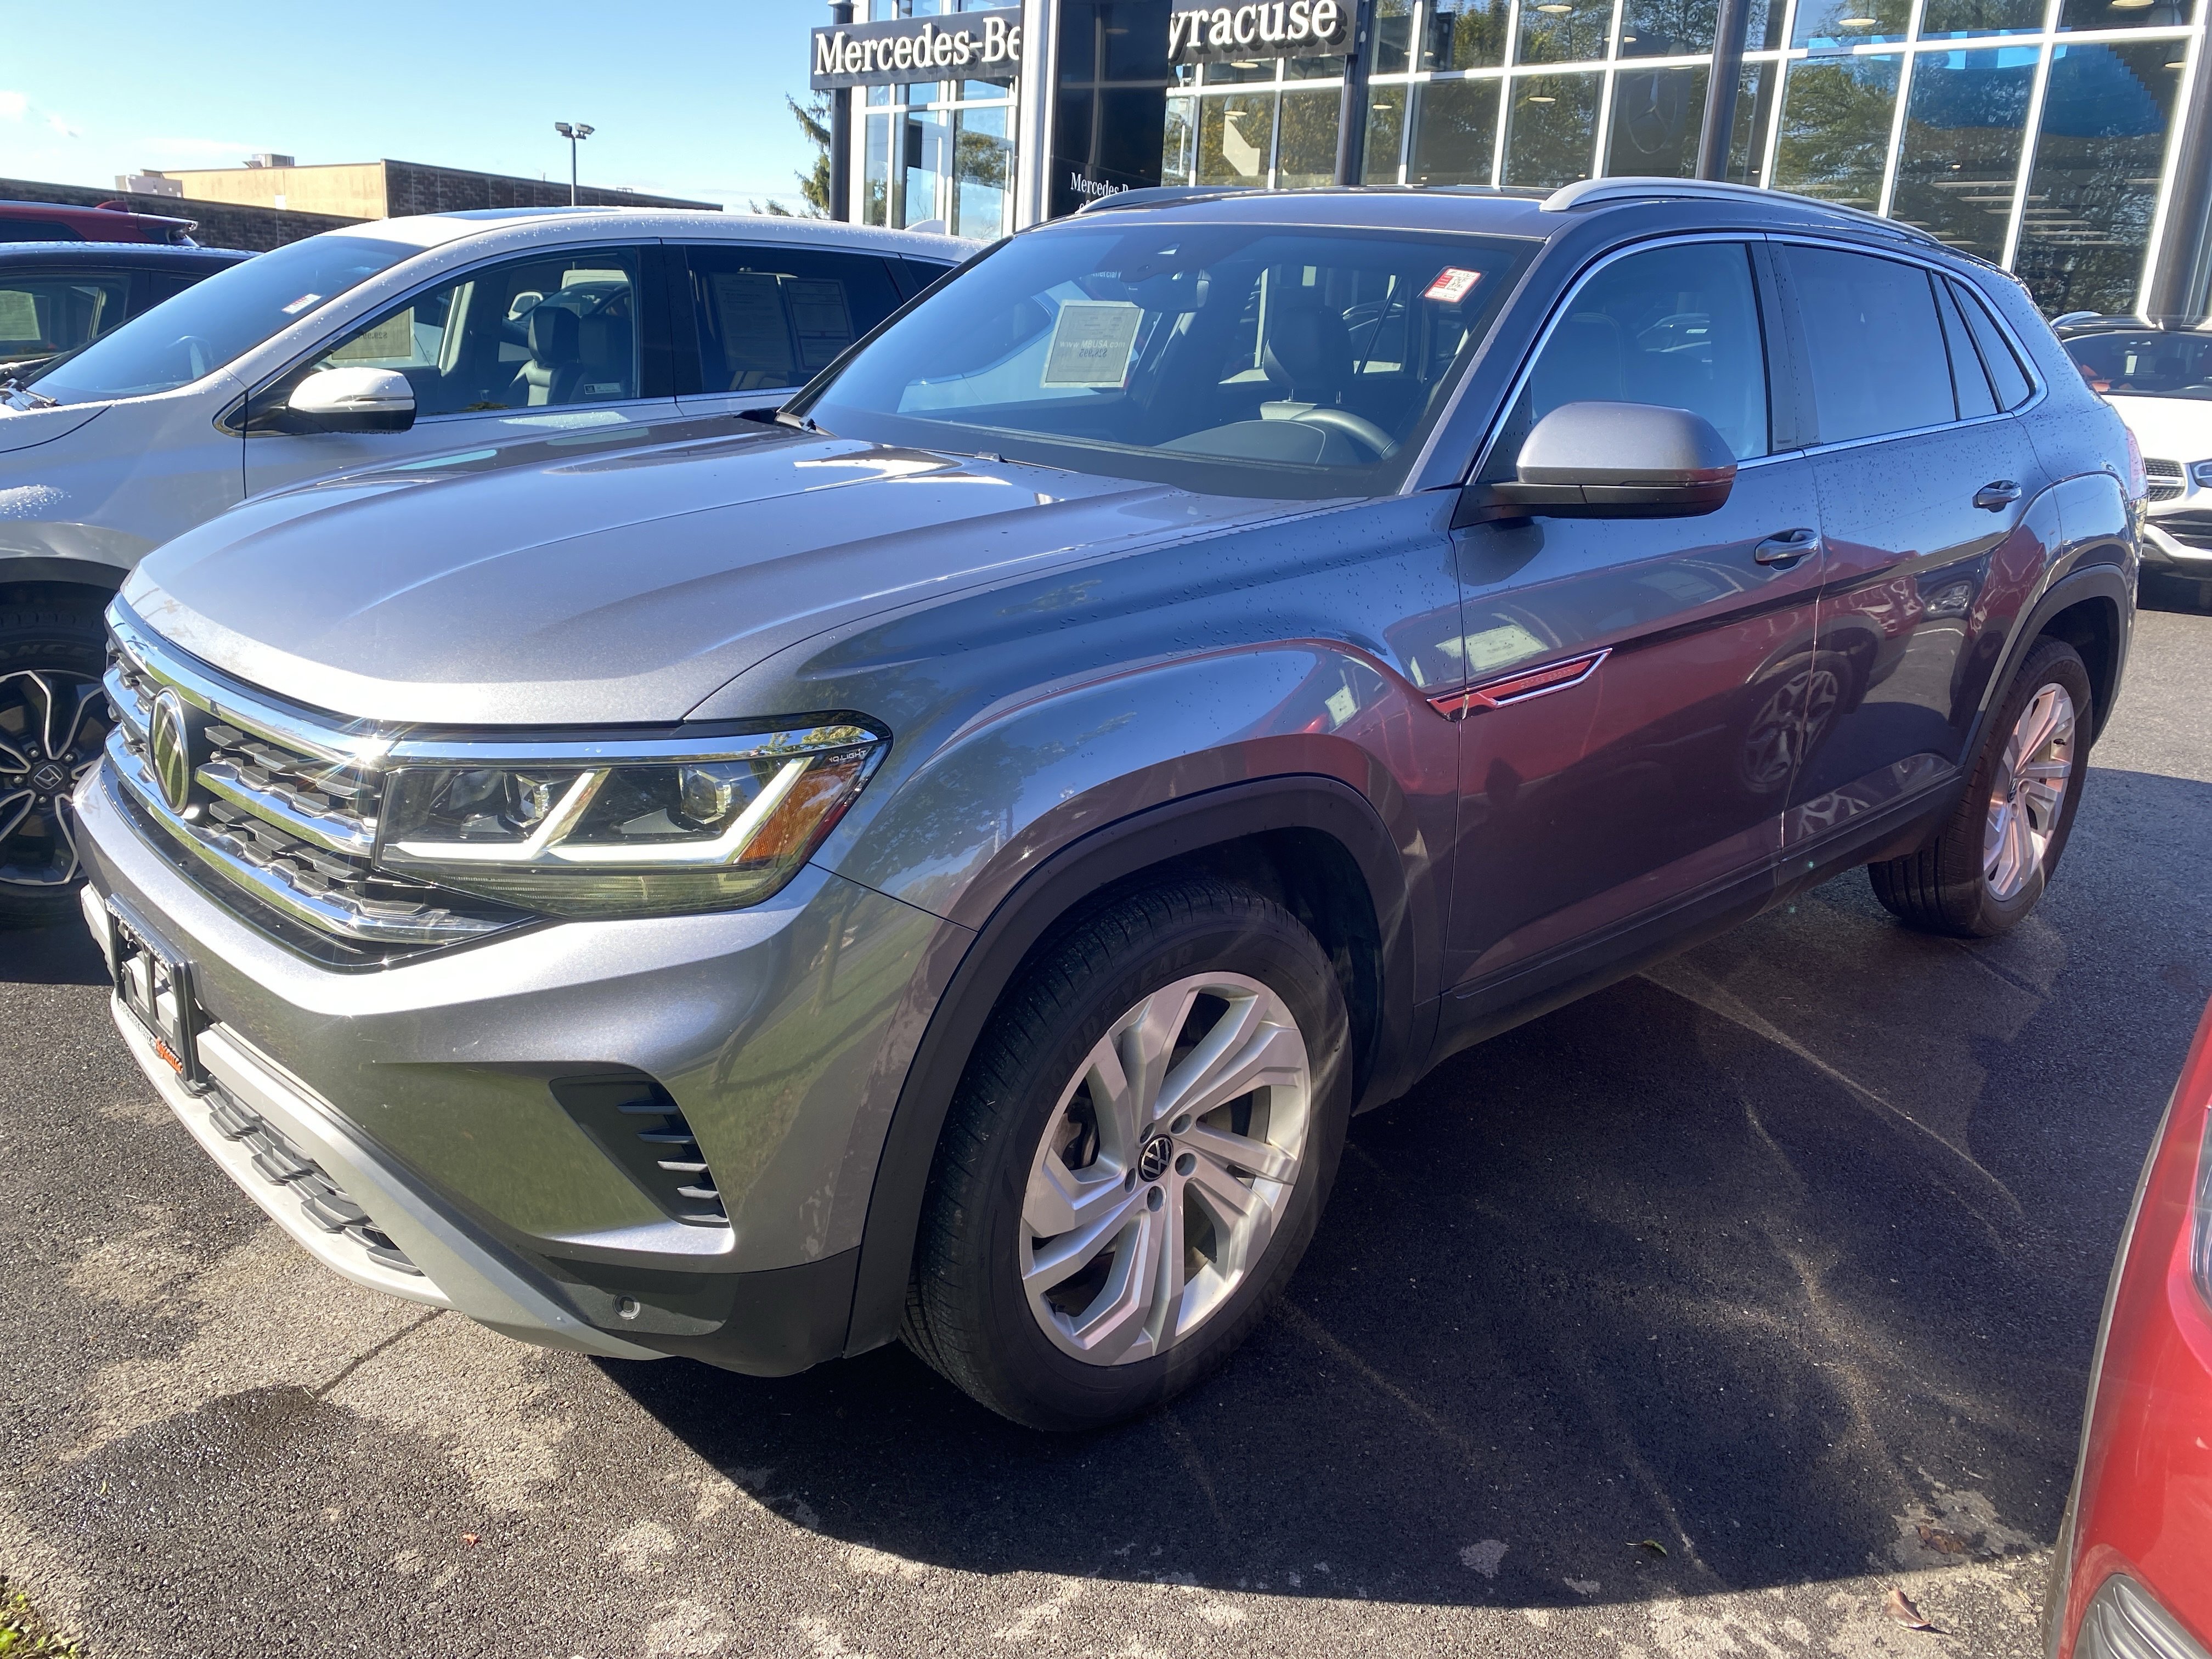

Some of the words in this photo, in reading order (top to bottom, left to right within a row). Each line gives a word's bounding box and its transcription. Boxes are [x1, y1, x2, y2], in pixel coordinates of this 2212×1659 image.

[814, 16, 1020, 75] Mercedes-Be
[1168, 0, 1338, 60] yracuse
[1070, 172, 1128, 196] Mercedes
